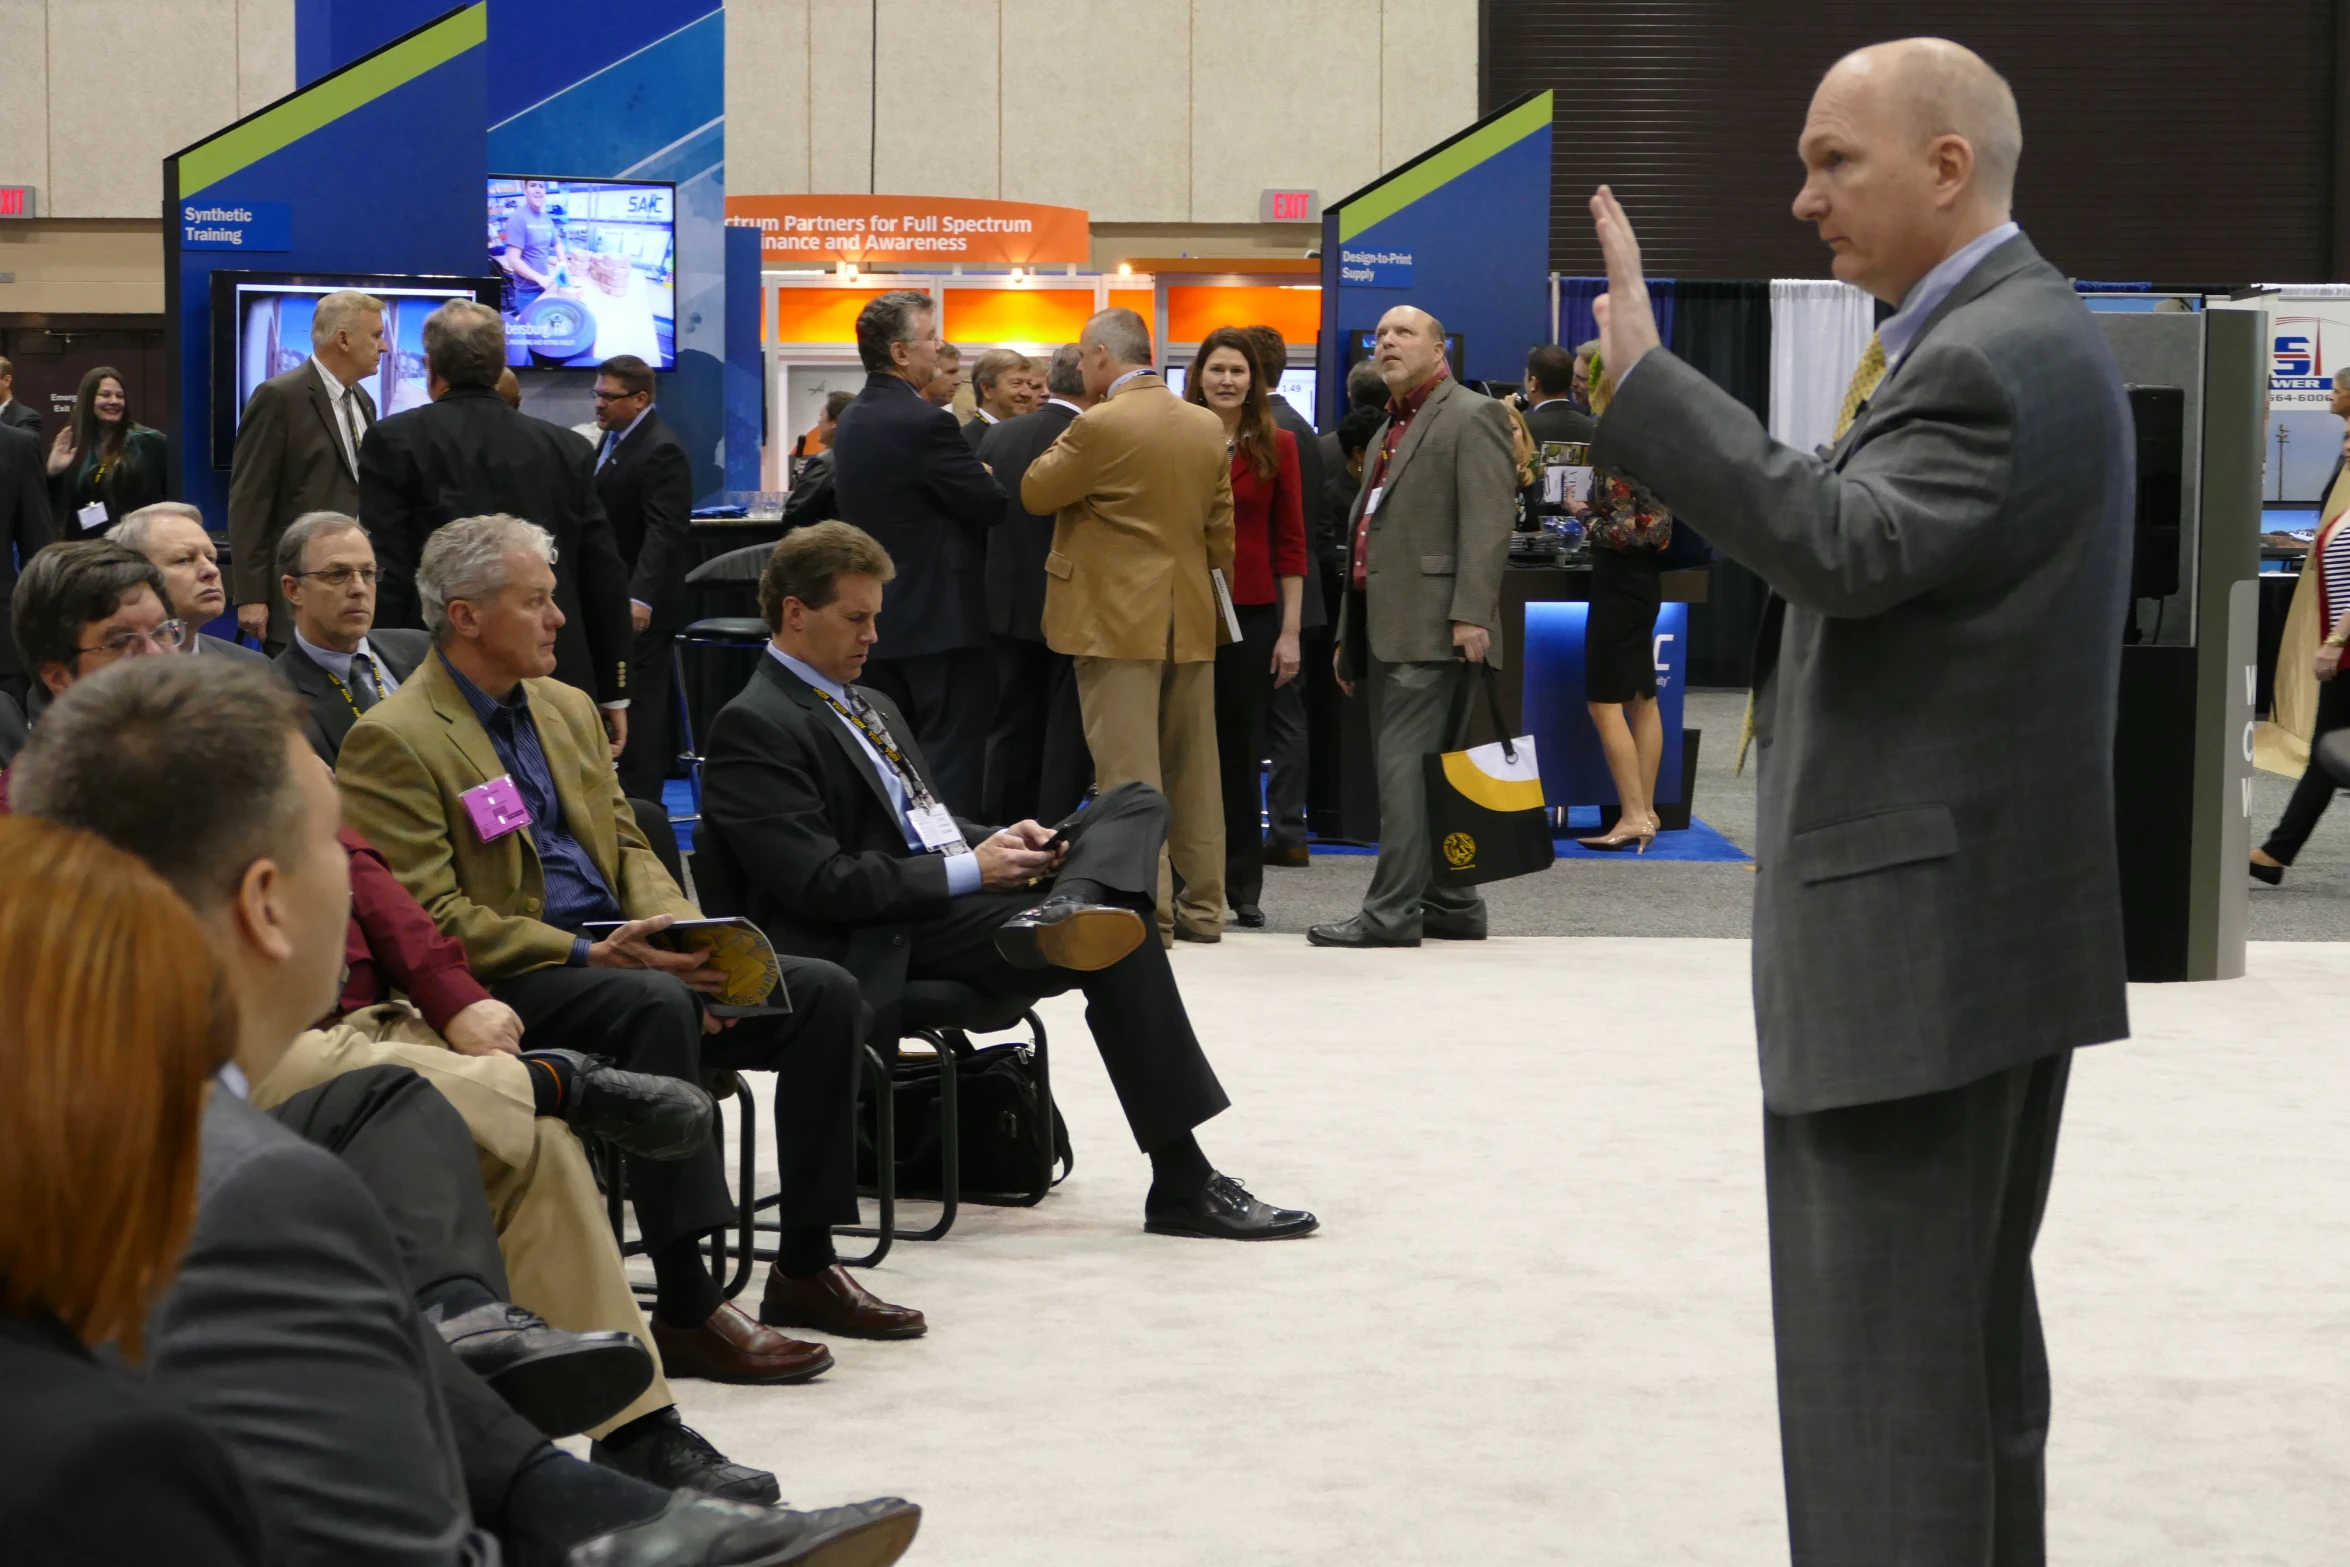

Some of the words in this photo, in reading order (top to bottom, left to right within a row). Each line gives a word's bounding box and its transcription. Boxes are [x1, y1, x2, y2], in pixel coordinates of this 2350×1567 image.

[1273, 193, 1309, 219] EXIT
[185, 207, 253, 224] Synthetic
[784, 216, 865, 231] Partners
[870, 215, 898, 232] for
[903, 216, 938, 232] Full
[942, 216, 1032, 235] Spectrum
[185, 227, 243, 245] Training
[825, 234, 860, 251] and
[865, 235, 968, 251] Awareness
[1342, 251, 1412, 265] Design-to-Print
[1342, 268, 1375, 282] Supply
[54, 404, 71, 412] Exit
